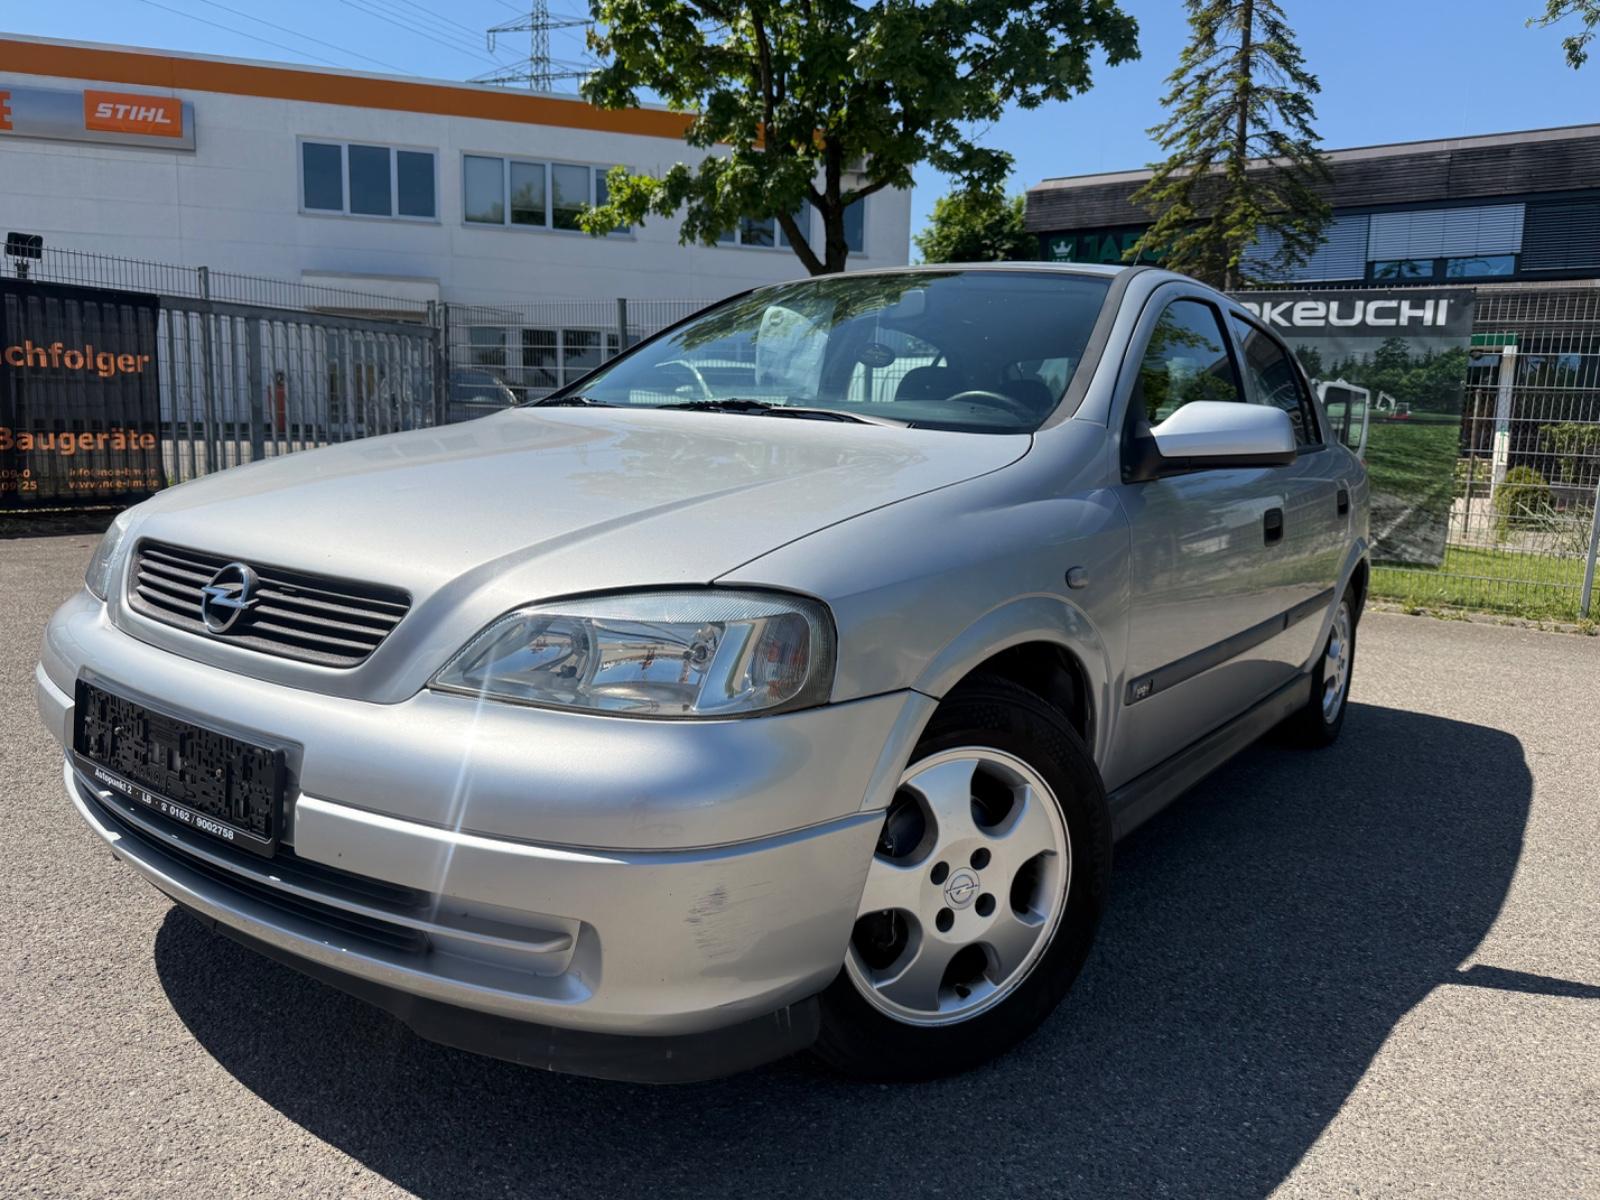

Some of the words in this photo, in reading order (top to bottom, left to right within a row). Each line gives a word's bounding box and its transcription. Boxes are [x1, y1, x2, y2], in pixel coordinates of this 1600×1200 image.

[95, 102, 171, 124] STIHL
[0, 340, 150, 377] chfolger
[94, 768, 127, 792] Autopunkt
[127, 785, 132, 795] 2
[141, 793, 152, 804] LB
[169, 805, 190, 820] 0162
[196, 817, 234, 841] 9002758
